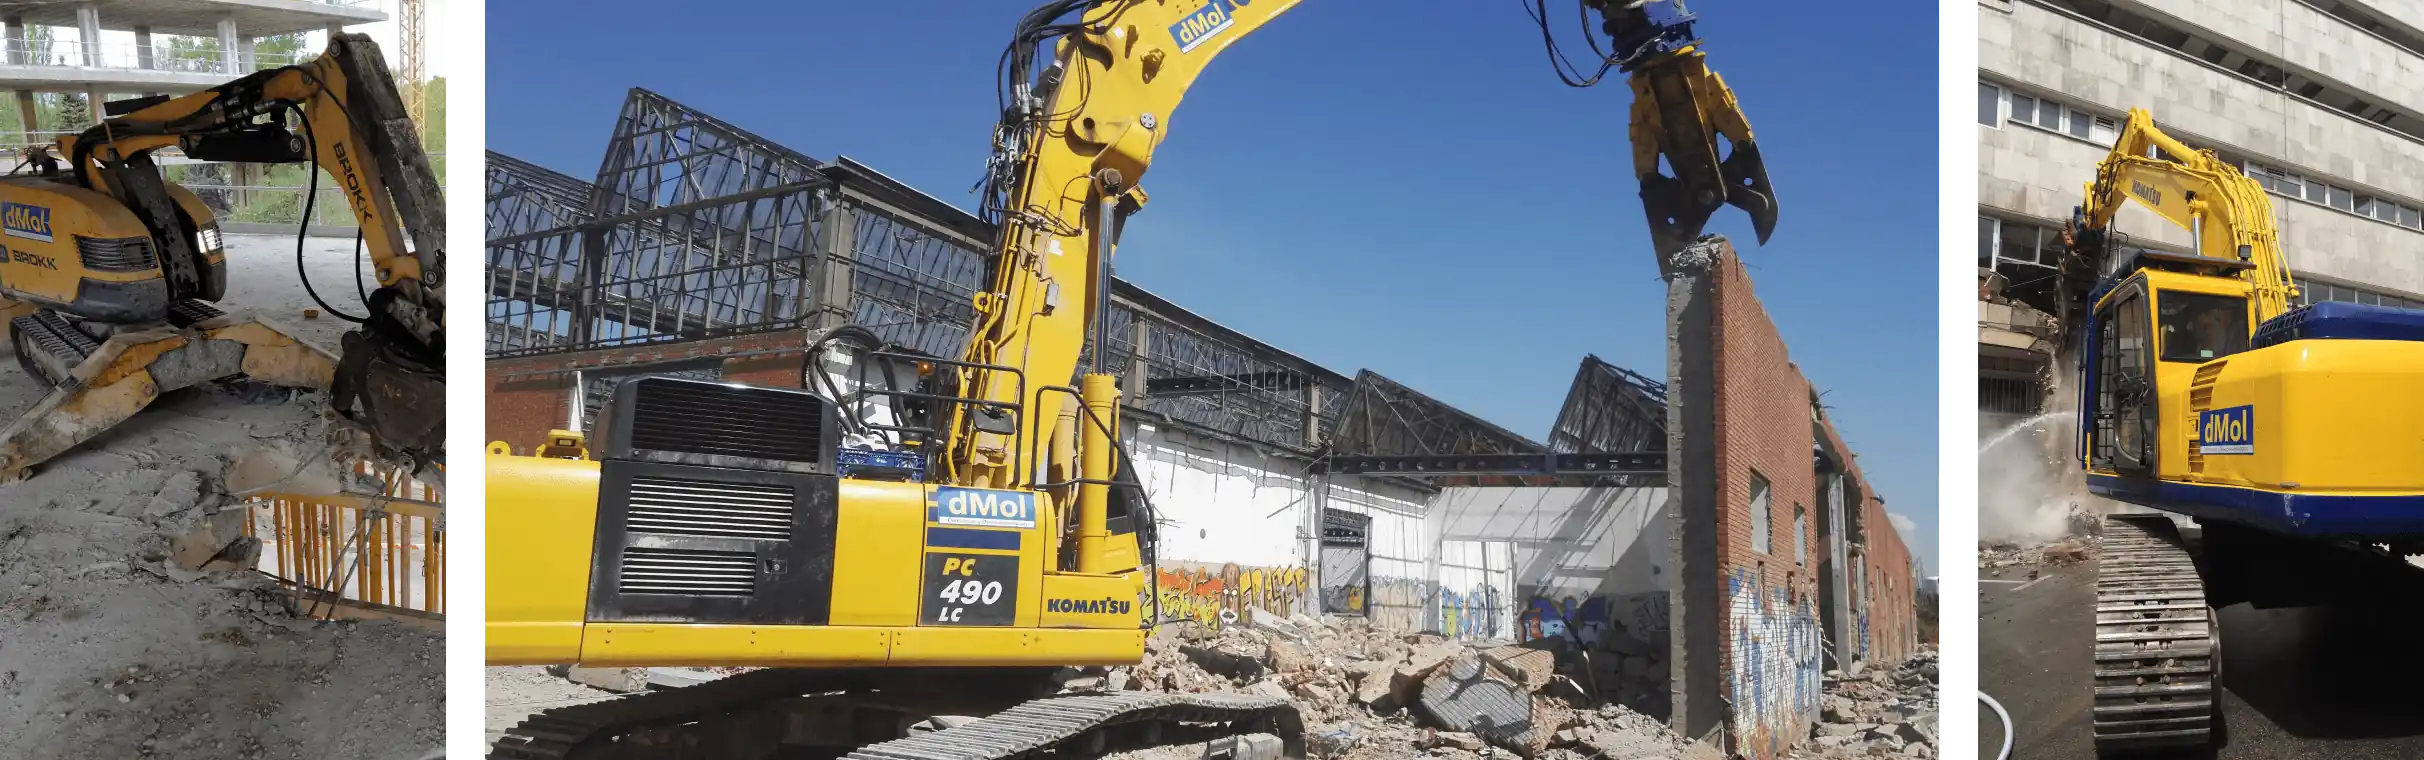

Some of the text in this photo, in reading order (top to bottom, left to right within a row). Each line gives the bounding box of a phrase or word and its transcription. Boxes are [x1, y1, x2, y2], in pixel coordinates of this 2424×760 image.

[1180, 2, 1226, 43] dMol
[333, 141, 373, 224] BROKK
[2132, 179, 2161, 206] KOMATSU
[6, 205, 47, 233] dMol
[12, 249, 58, 271] BROKK
[2205, 409, 2247, 443] dMol
[948, 491, 1027, 518] dMol
[942, 557, 976, 577] PC
[939, 579, 1003, 605] 490
[1047, 596, 1131, 615] KOMATSU
[938, 606, 964, 622] LC
